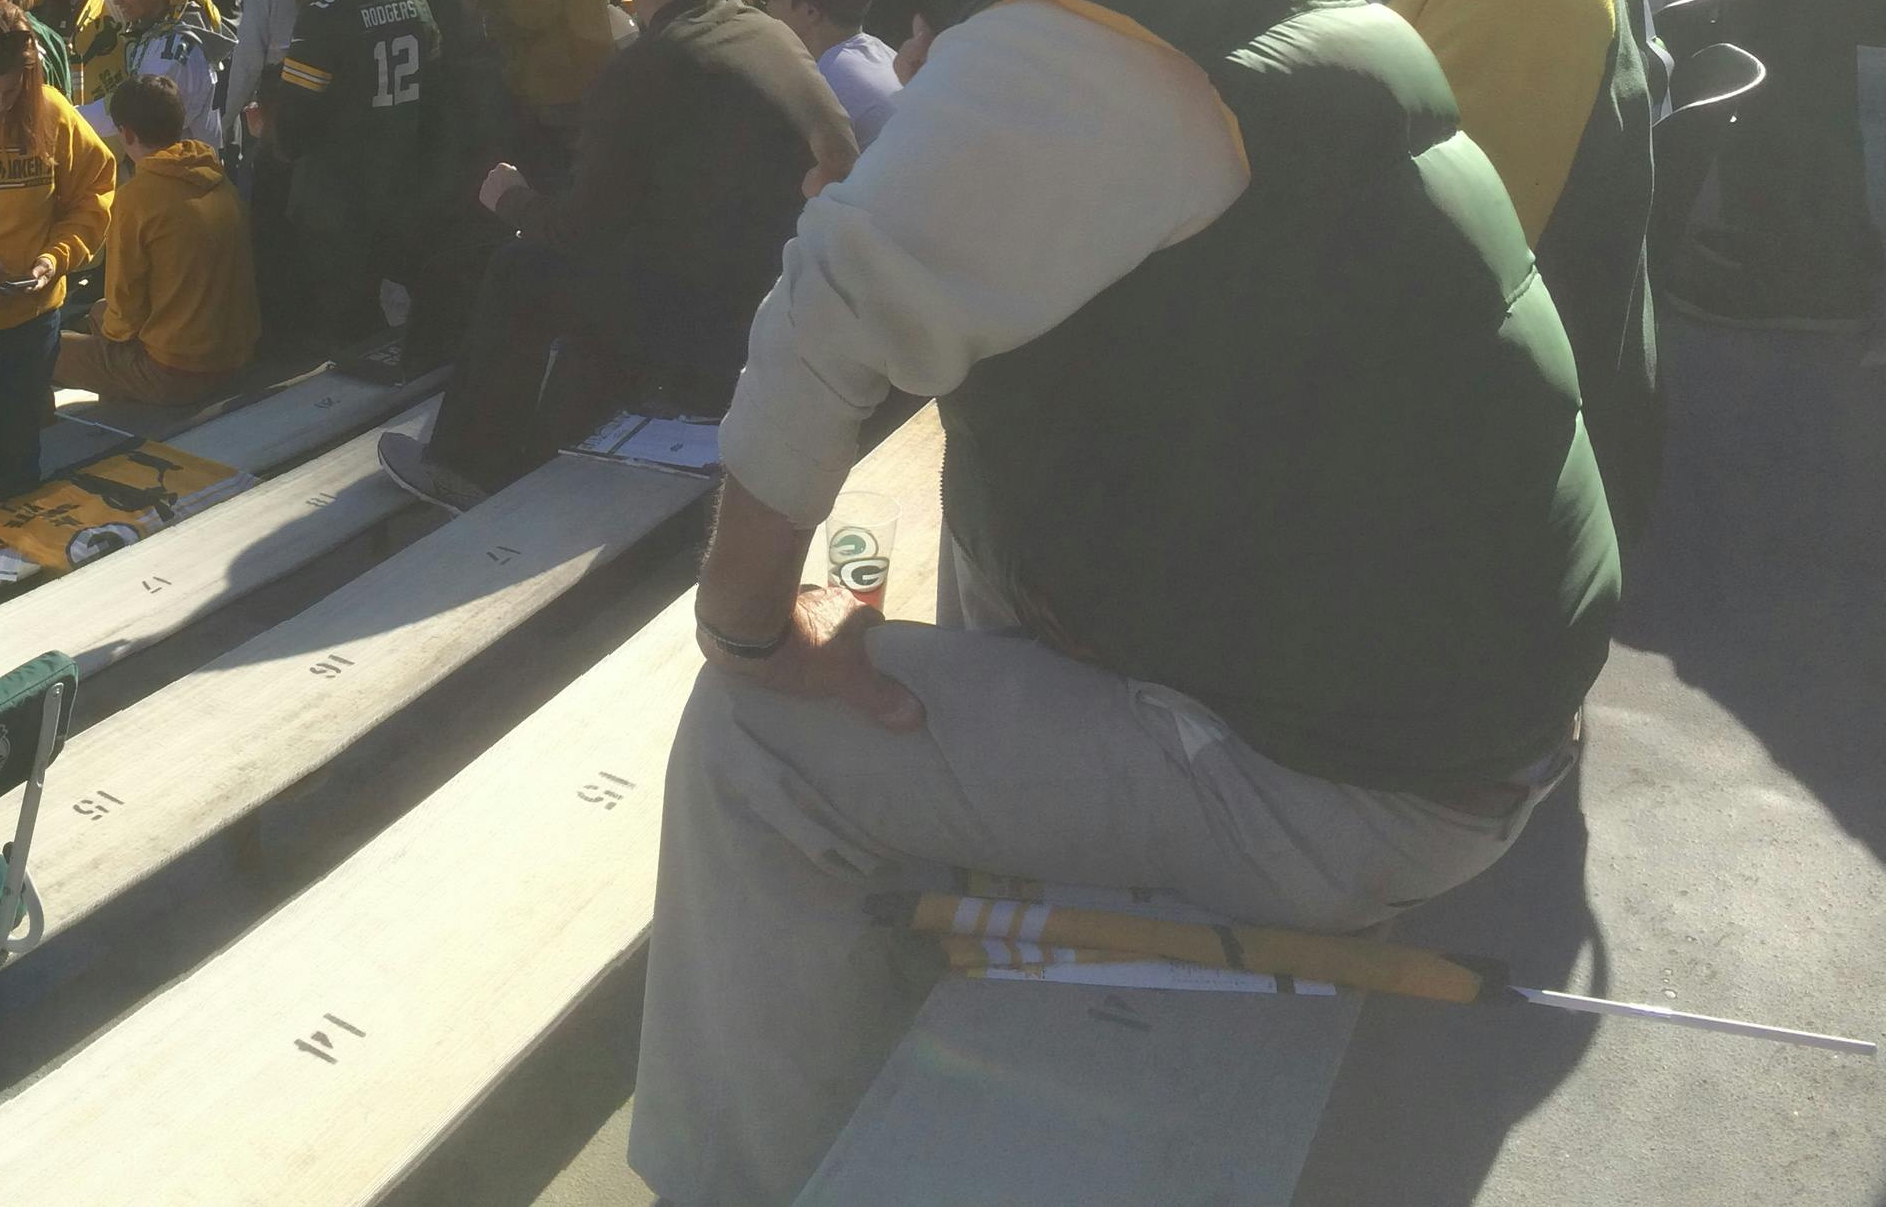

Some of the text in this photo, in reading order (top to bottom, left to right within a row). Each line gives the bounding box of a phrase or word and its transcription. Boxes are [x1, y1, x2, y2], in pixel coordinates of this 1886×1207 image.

[362, 0, 418, 29] RODGERS
[371, 34, 421, 108] 12
[309, 653, 356, 679] 16
[72, 789, 126, 822] 15
[576, 770, 638, 811] 15
[293, 1012, 367, 1065] 14
